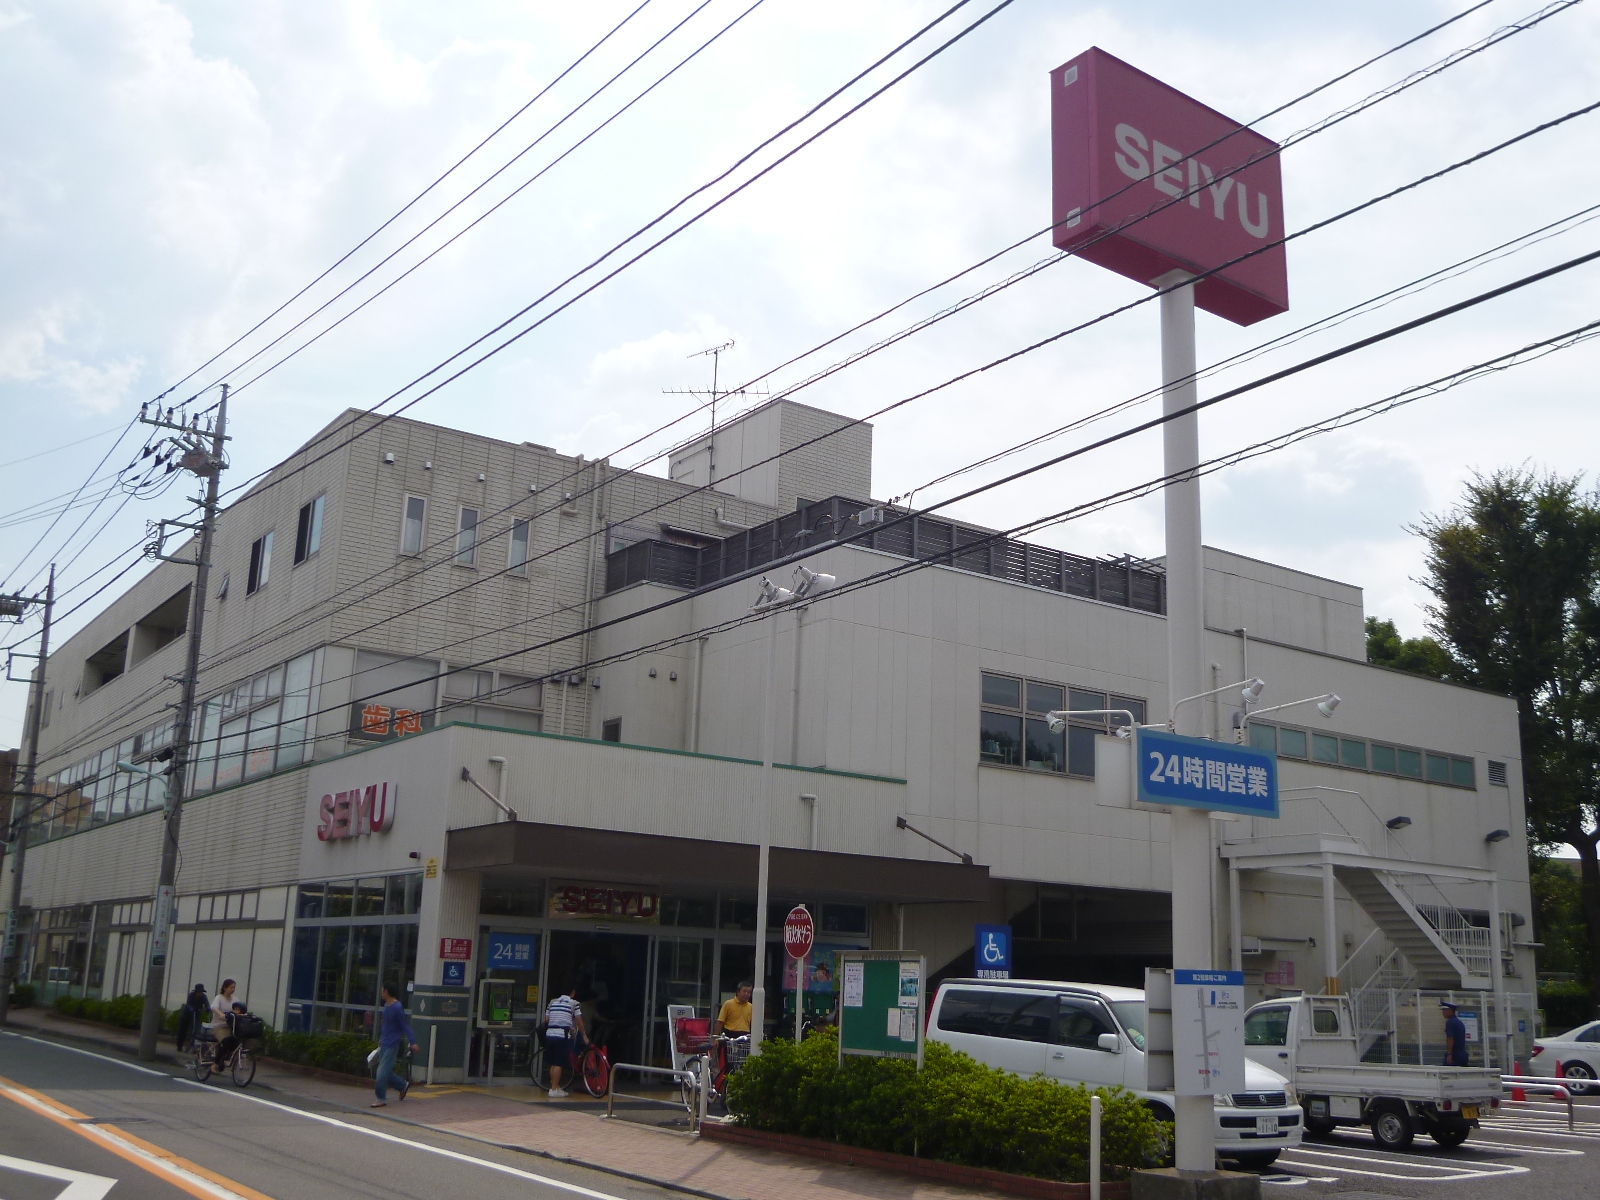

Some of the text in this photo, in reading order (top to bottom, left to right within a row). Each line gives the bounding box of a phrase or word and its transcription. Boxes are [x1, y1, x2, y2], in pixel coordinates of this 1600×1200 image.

[1114, 122, 1269, 239] SEIYU
[362, 703, 423, 737] 歯科
[1149, 751, 1268, 798] 24時間営業
[317, 781, 398, 842] SEIYU
[562, 885, 658, 917] SEIYU
[493, 943, 513, 960] 24
